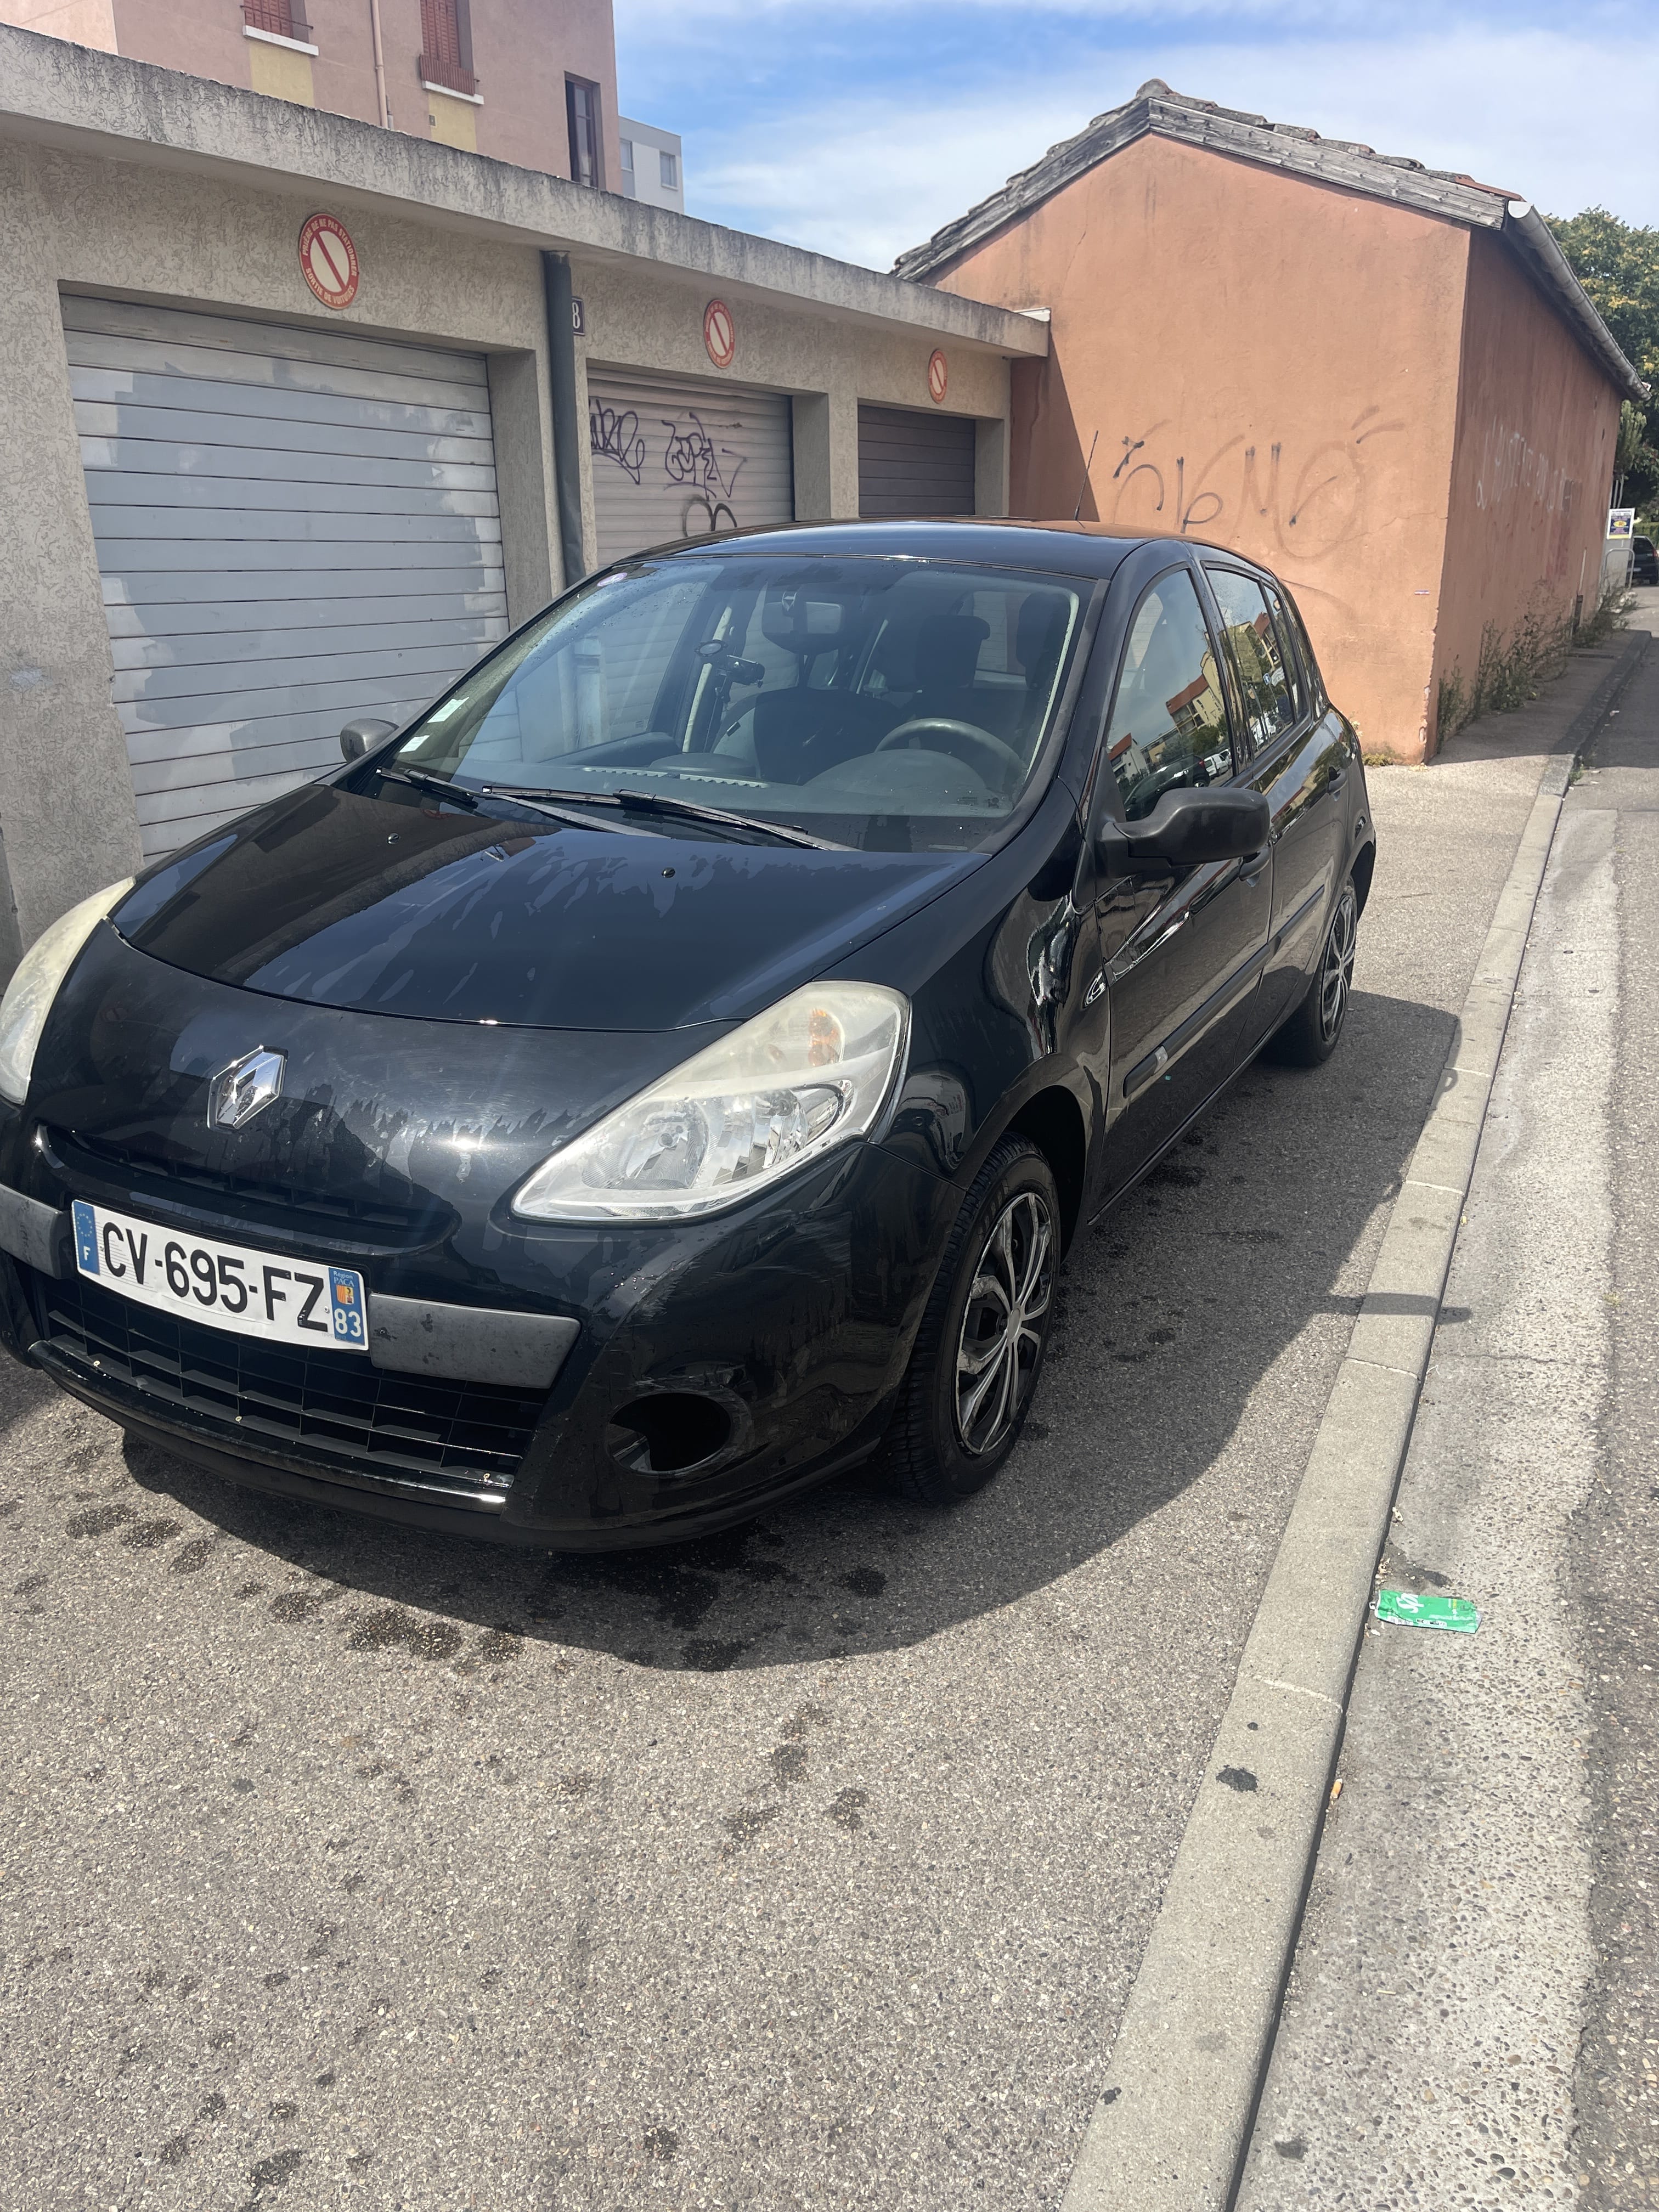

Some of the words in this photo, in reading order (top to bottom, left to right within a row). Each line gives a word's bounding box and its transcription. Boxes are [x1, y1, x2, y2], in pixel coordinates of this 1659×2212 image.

[311, 221, 319, 231] DE
[319, 218, 326, 227] NE
[328, 219, 338, 232] PAS
[306, 268, 323, 296] SORTIE
[324, 291, 332, 302] DE
[332, 285, 355, 304] VOITURES
[83, 1245, 91, 1261] F
[103, 1222, 328, 1333] CV-695-FZ
[334, 1277, 354, 1287] PACA
[334, 1308, 362, 1338] 83
